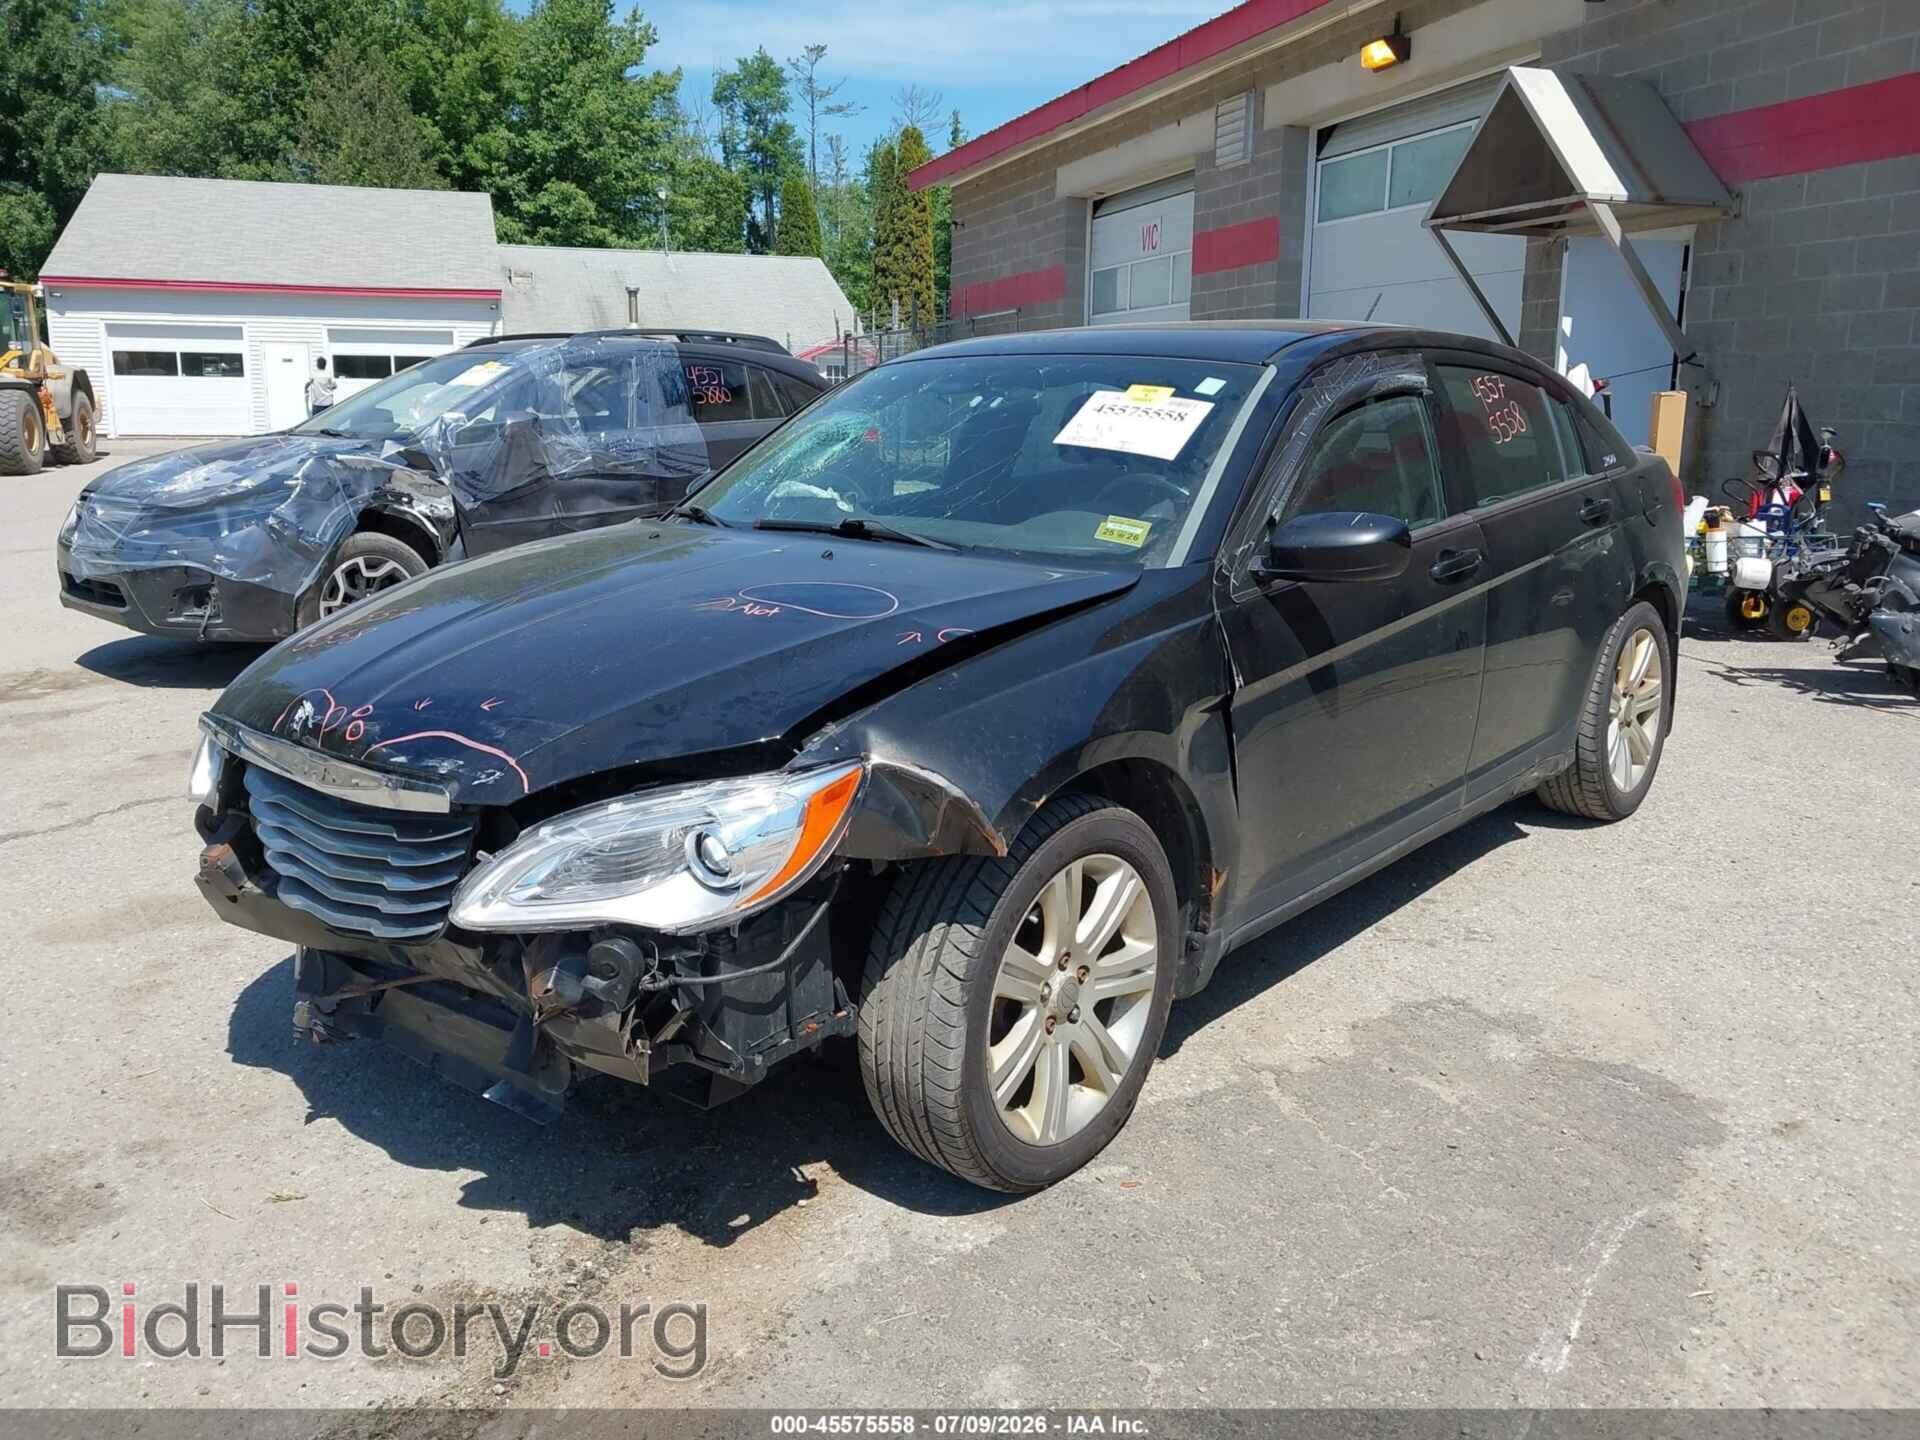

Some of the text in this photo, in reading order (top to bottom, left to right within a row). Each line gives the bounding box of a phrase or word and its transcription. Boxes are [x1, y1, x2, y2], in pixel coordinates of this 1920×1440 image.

[1141, 223, 1159, 252] VIC
[685, 365, 725, 386] 4557
[1467, 375, 1506, 413] 4557
[1093, 403, 1189, 423] 45575558
[1488, 400, 1527, 445] 5558
